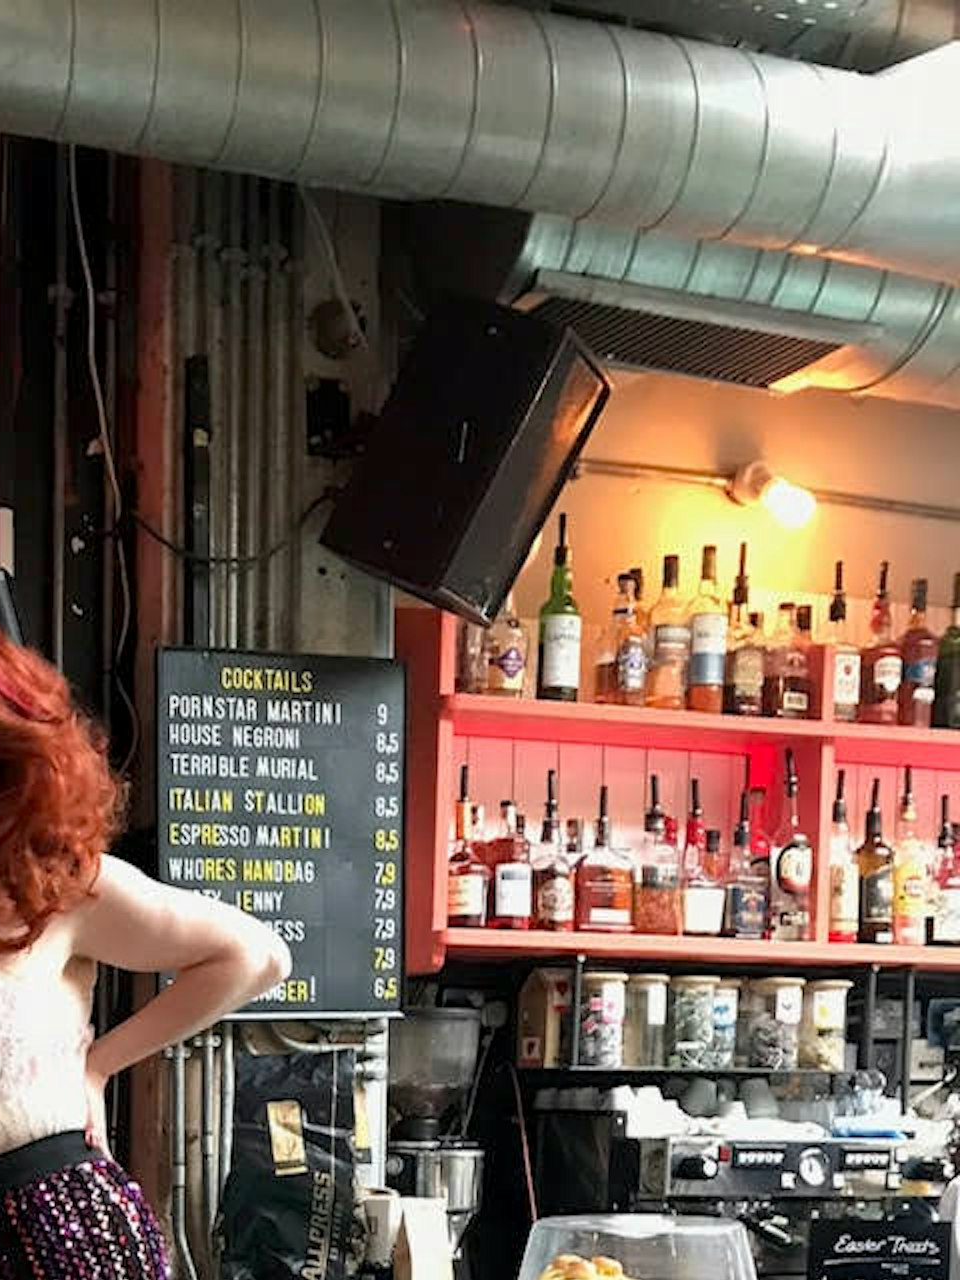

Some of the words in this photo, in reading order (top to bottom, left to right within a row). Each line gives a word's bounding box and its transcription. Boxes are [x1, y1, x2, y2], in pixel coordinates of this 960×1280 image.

[221, 667, 314, 692] COCKTAILS
[168, 695, 257, 721] PORNSTAR
[267, 700, 341, 725] MARTINI
[377, 703, 388, 726] 9
[168, 723, 221, 747] HOUSE
[233, 726, 300, 749] NEGRONI
[169, 753, 249, 778] TERRIBLE
[256, 757, 318, 781] MURIAL
[168, 787, 233, 811] ITALIAN
[244, 789, 326, 816] STALLION
[168, 822, 249, 847] ESPRESSO
[256, 825, 330, 849] MARTINI
[168, 857, 237, 881] WHORES
[243, 859, 315, 883] HANDBAG
[834, 1233, 886, 1254] Easter
[888, 1235, 939, 1255] Treats
